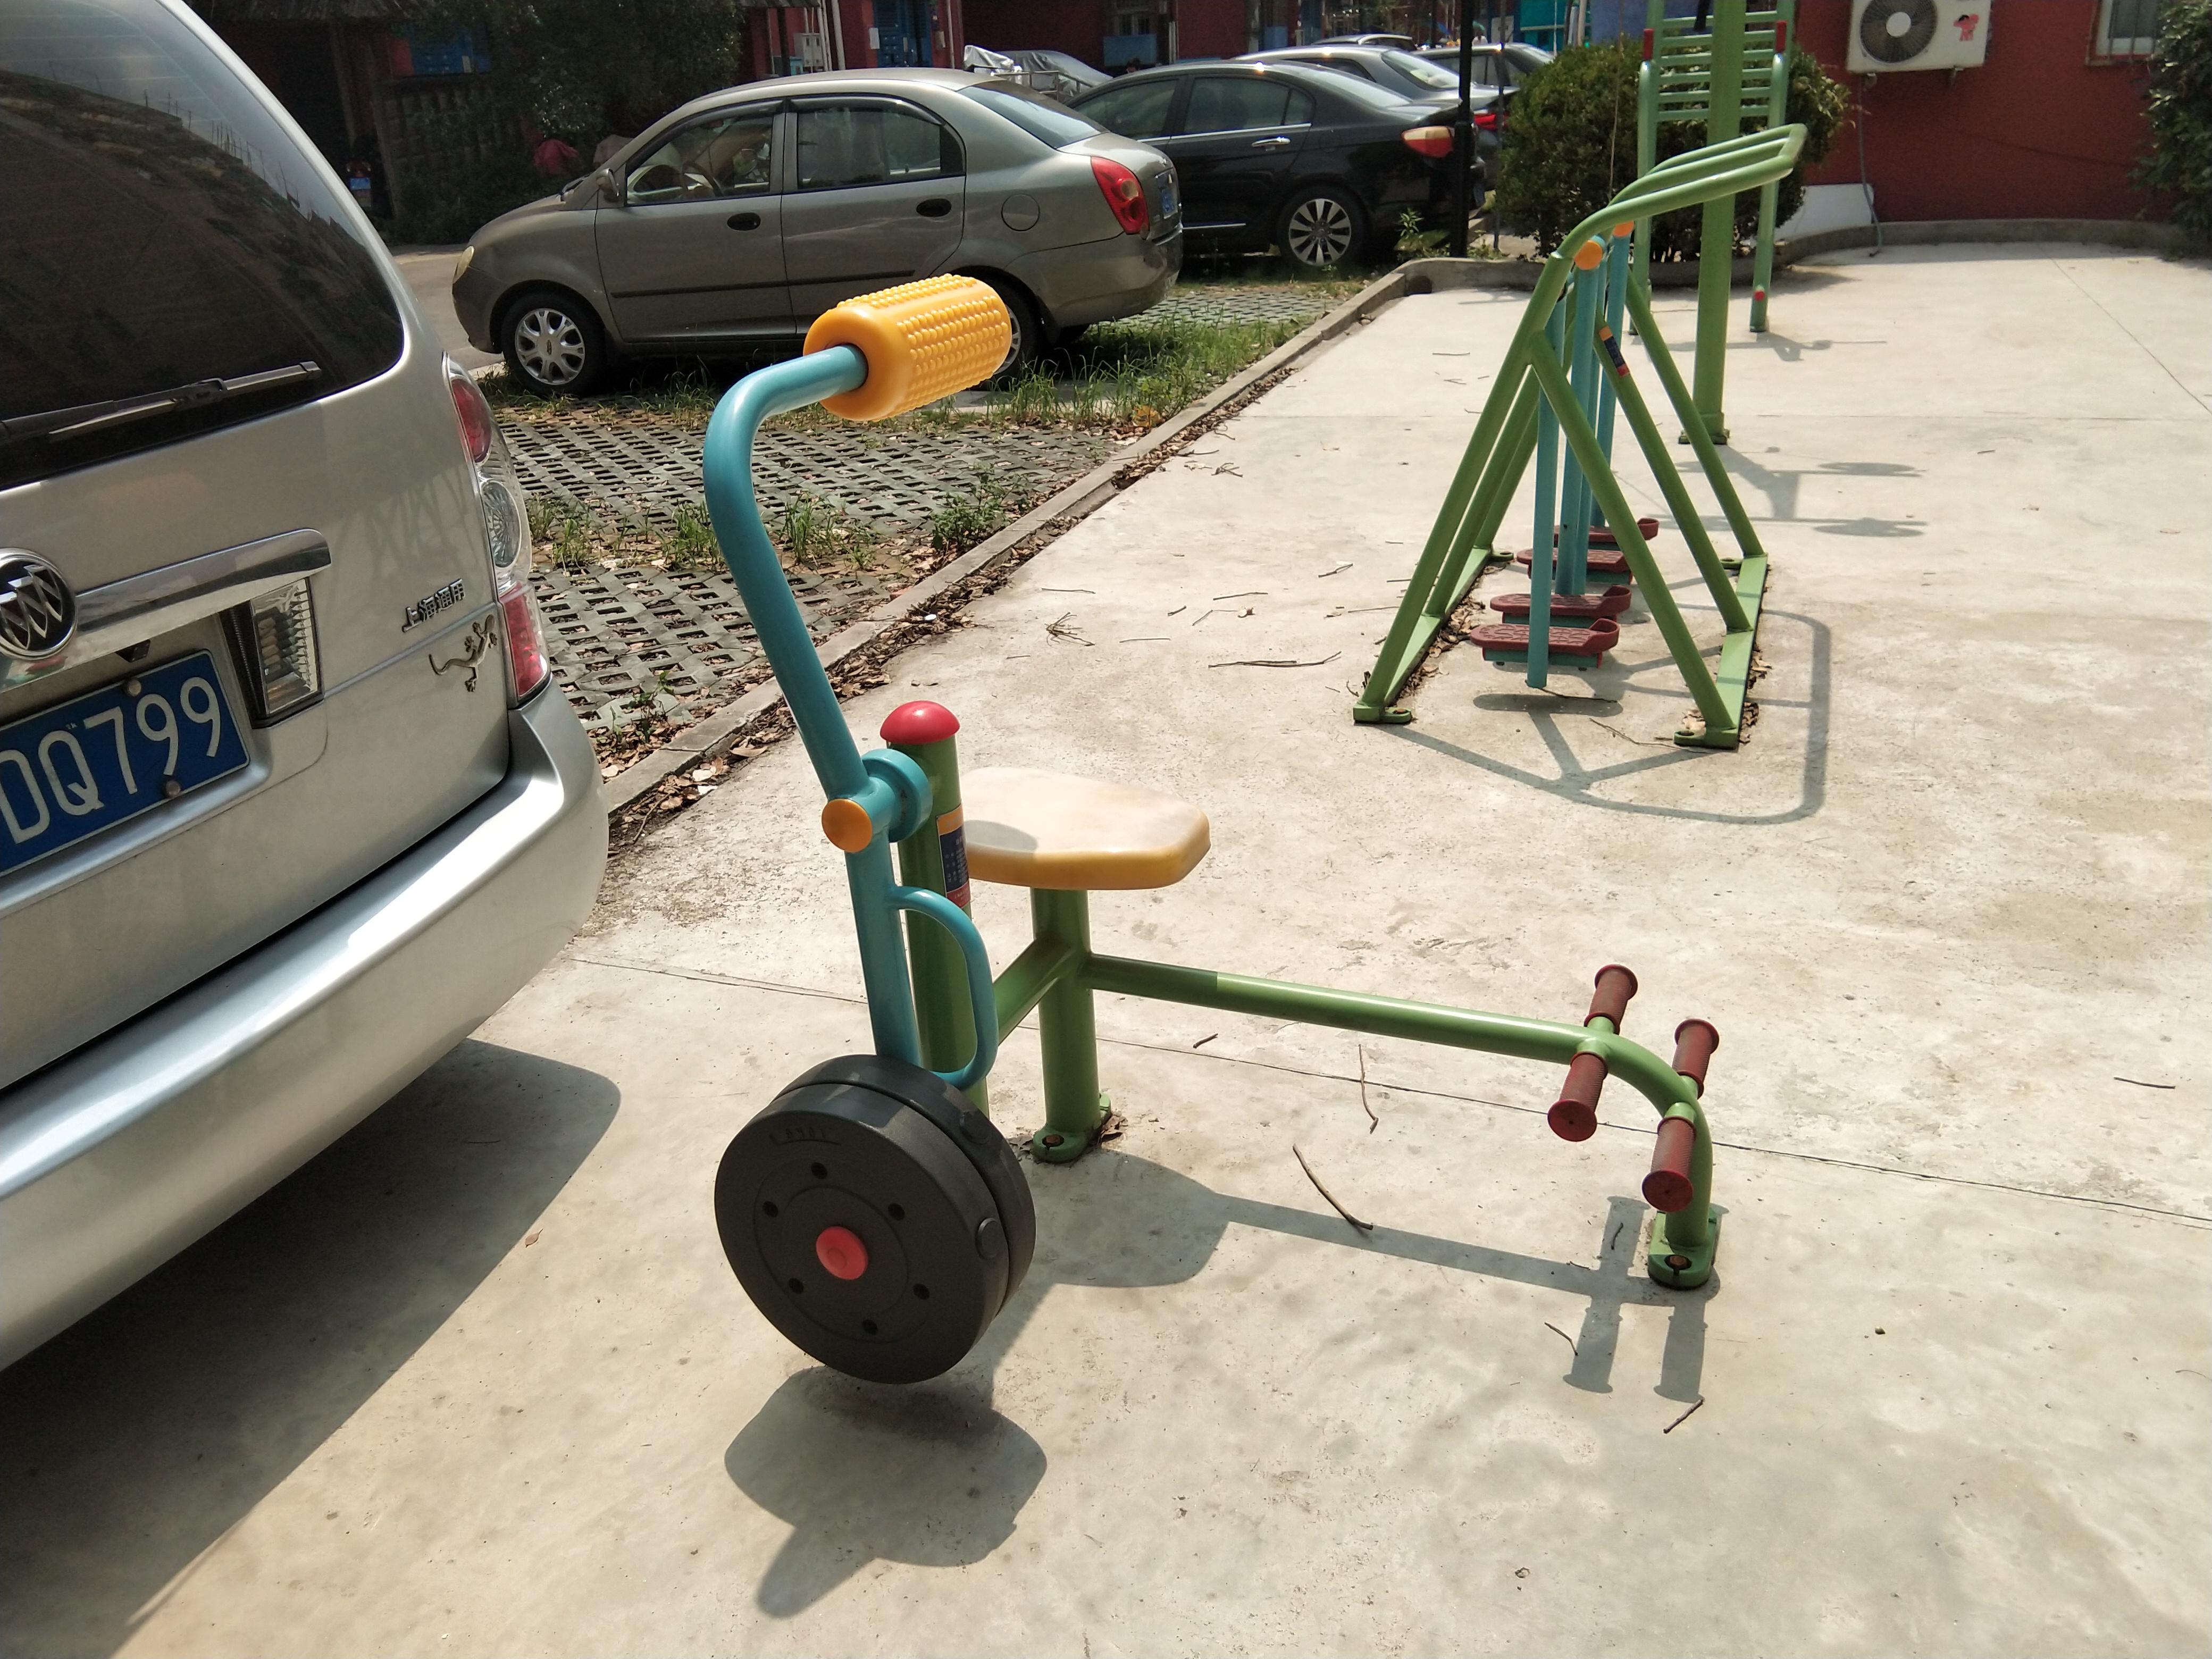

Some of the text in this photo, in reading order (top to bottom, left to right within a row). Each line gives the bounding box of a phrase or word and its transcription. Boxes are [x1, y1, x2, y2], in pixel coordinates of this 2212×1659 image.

[401, 577, 466, 633] 上海通用
[0, 676, 221, 844] DQ799
